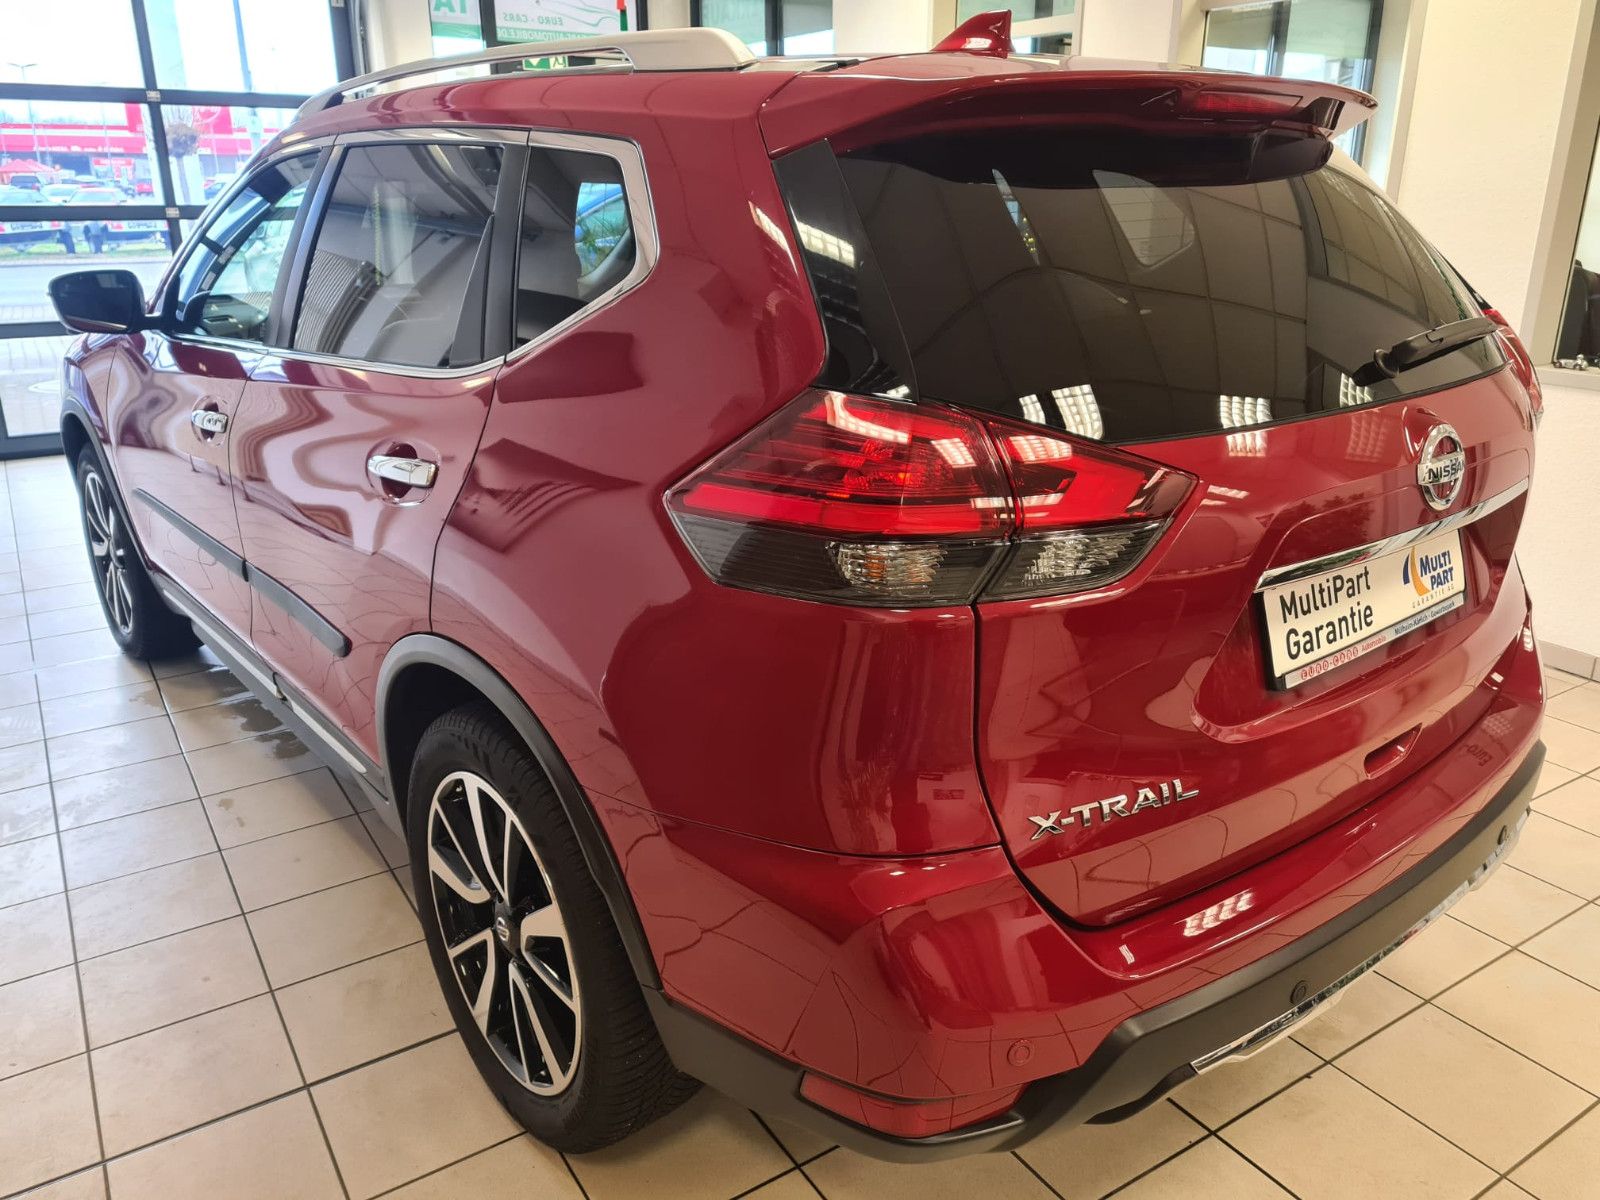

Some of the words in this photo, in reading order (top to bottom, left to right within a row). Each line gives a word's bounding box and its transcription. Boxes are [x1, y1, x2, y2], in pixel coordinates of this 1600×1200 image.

[1419, 550, 1451, 578] MULTI
[1430, 566, 1454, 591] PART
[1279, 565, 1371, 624] MultiPart
[1286, 601, 1374, 661] Garantie
[1027, 778, 1199, 841] X-TRAIL
